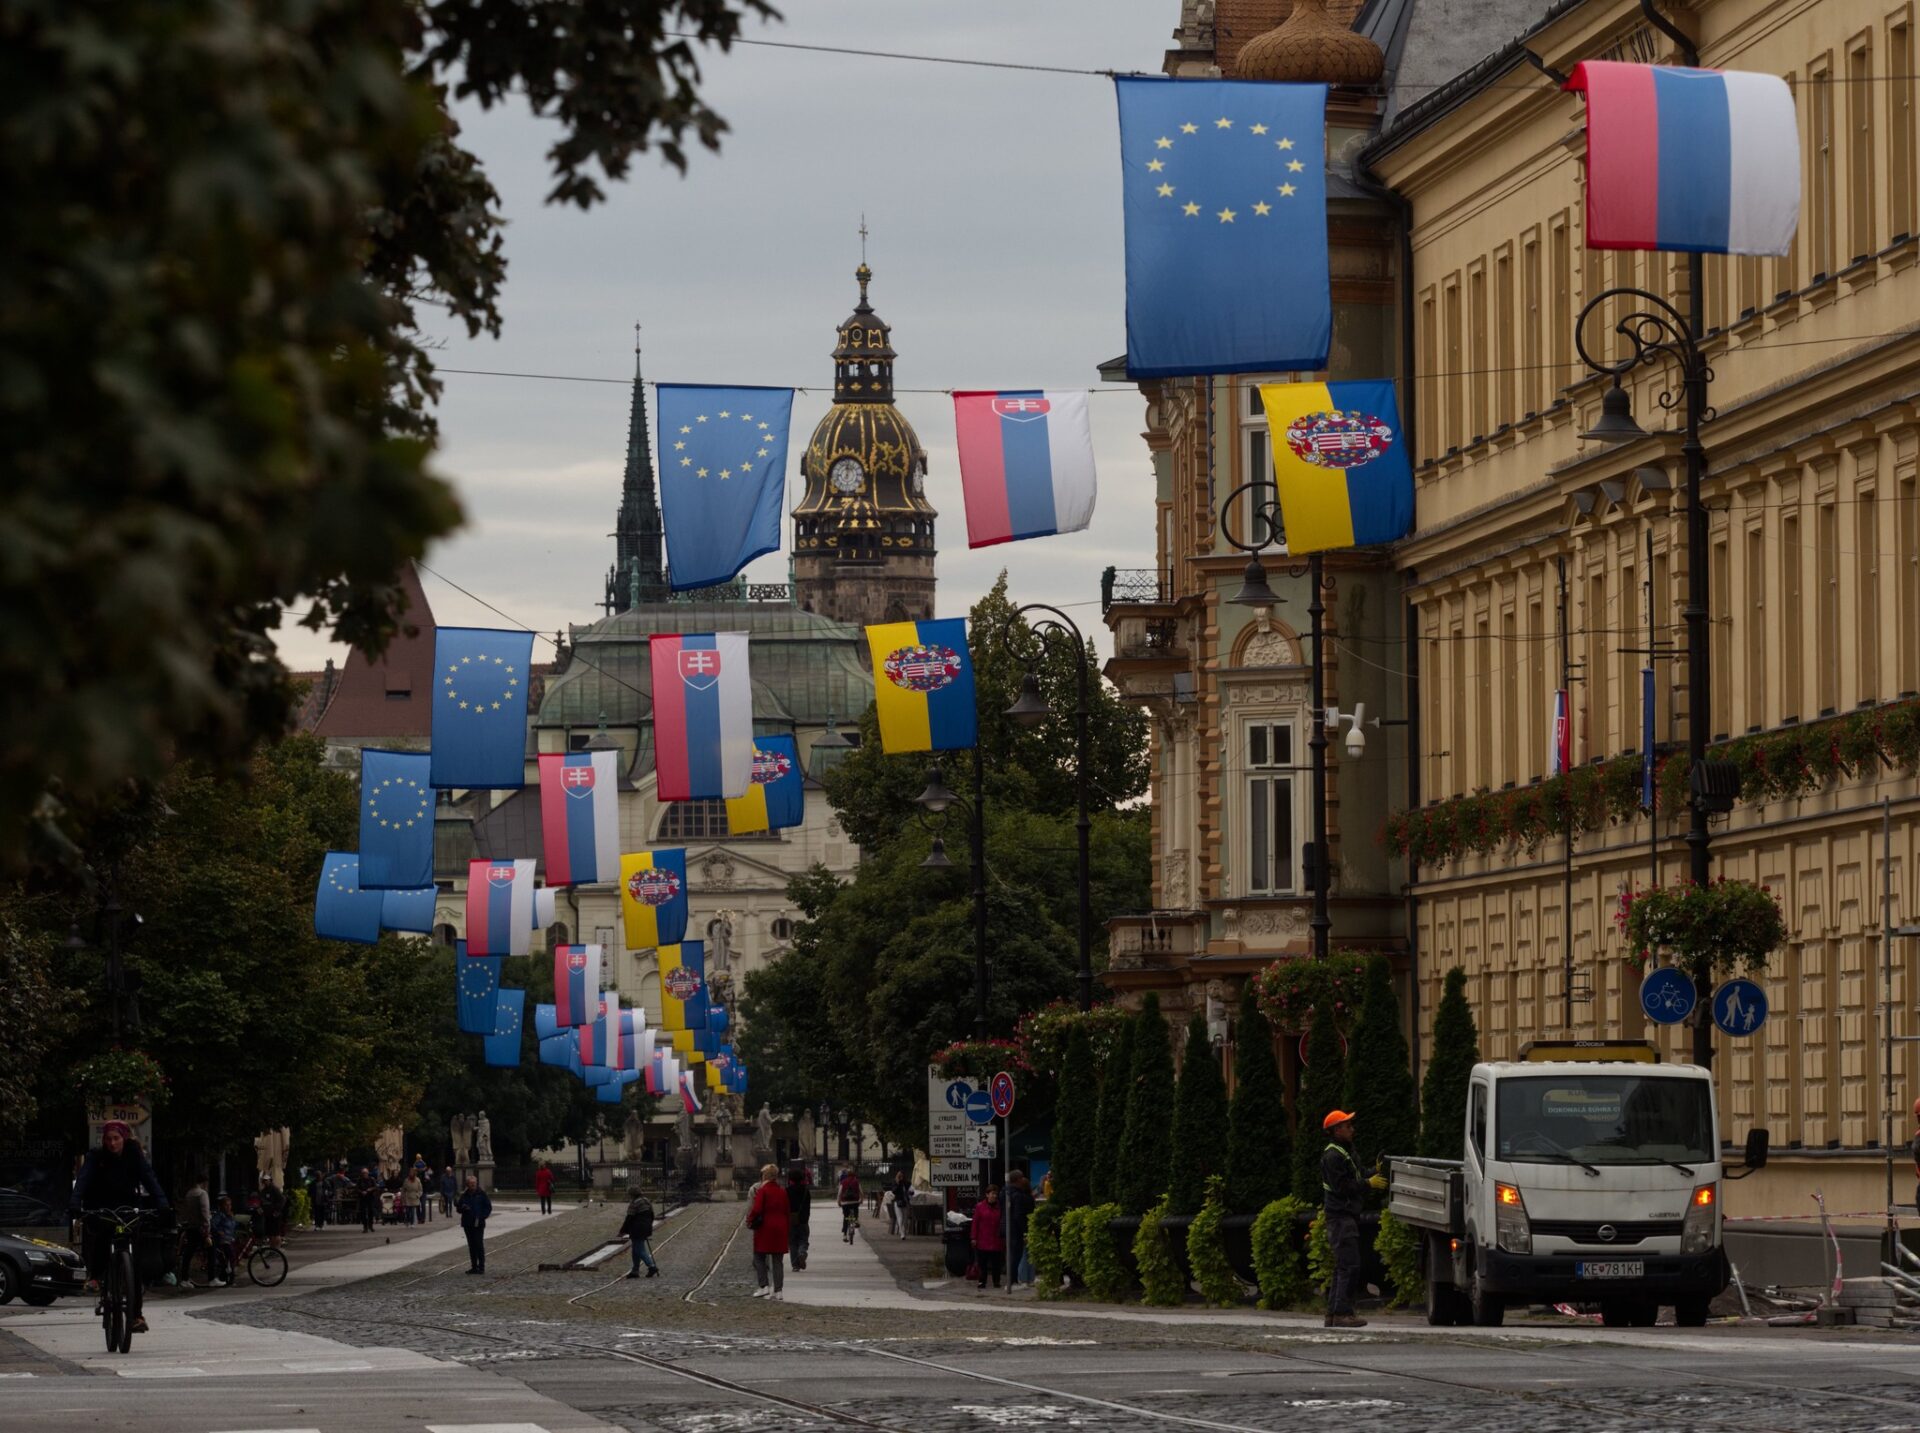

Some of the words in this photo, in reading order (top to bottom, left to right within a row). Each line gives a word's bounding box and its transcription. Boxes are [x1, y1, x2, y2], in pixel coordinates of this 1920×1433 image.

[112, 1108, 138, 1121] 50m
[949, 1162, 972, 1170] OKREM
[933, 1173, 969, 1182] POVOLENIA
